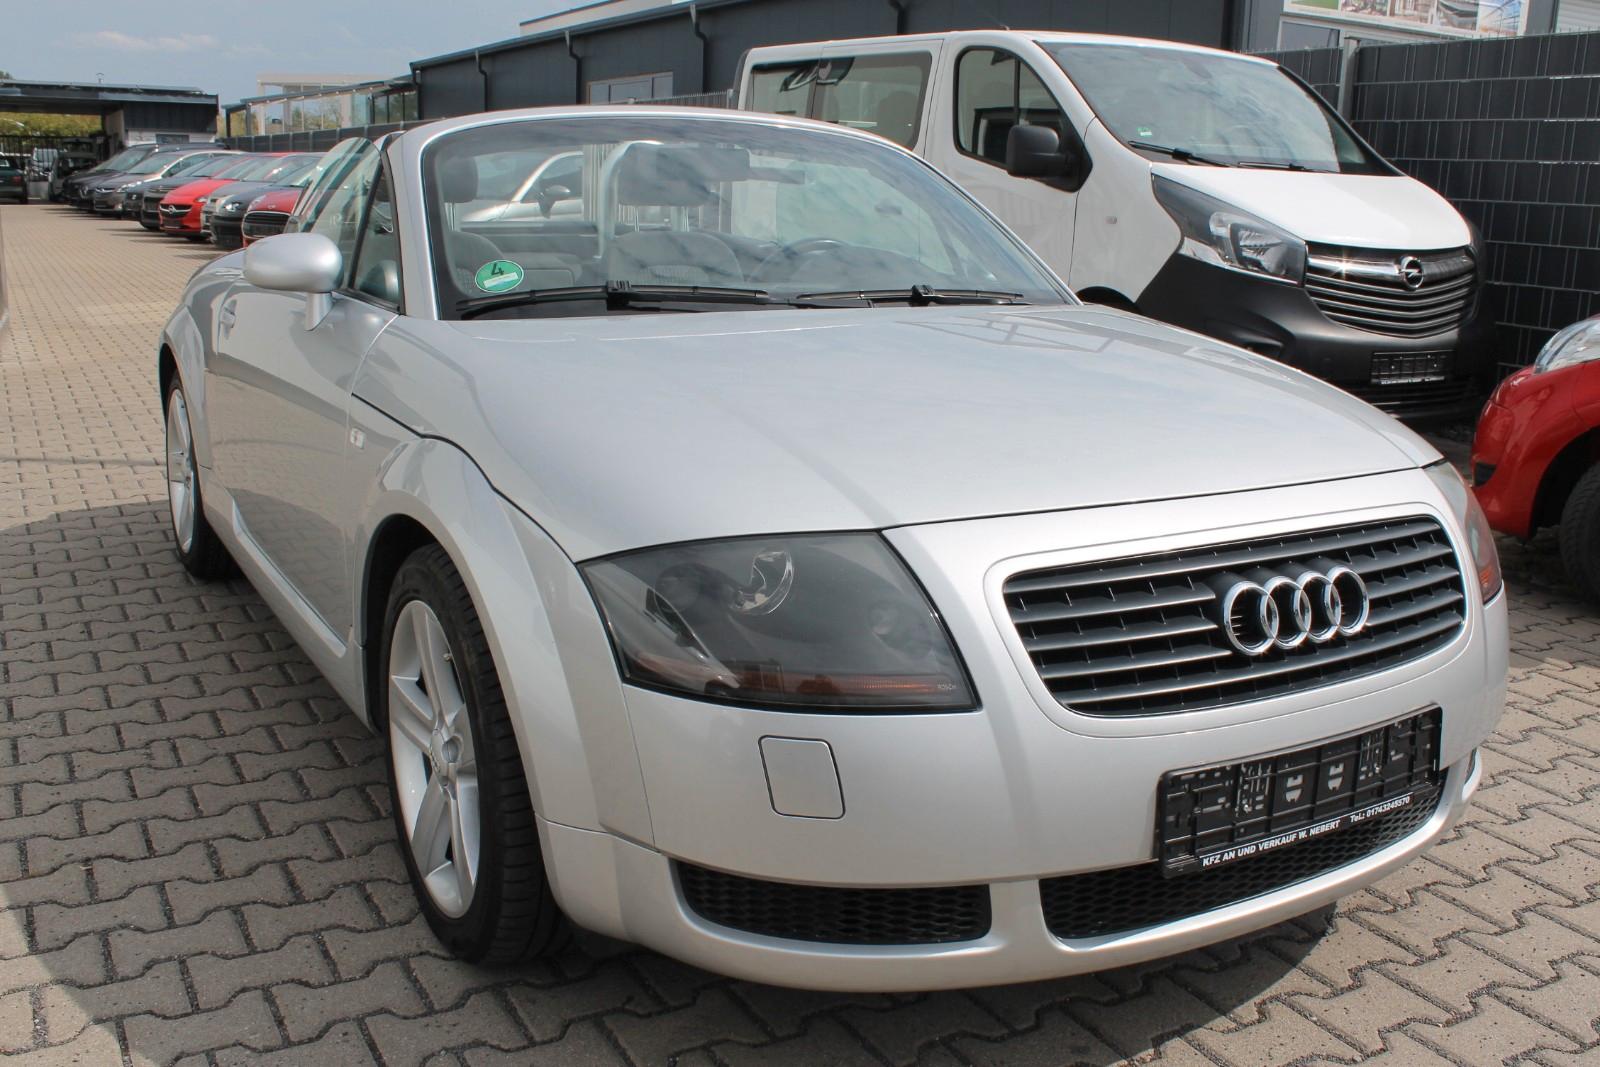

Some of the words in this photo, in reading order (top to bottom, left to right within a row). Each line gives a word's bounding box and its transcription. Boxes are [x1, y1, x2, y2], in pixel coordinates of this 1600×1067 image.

[491, 262, 504, 275] 4
[1202, 855, 1221, 867] KFZ
[1222, 851, 1236, 861] AN
[1237, 845, 1257, 857] UND
[1258, 833, 1297, 851] VERKAUF
[1298, 831, 1308, 840] W.
[1309, 820, 1341, 837] NEBERT
